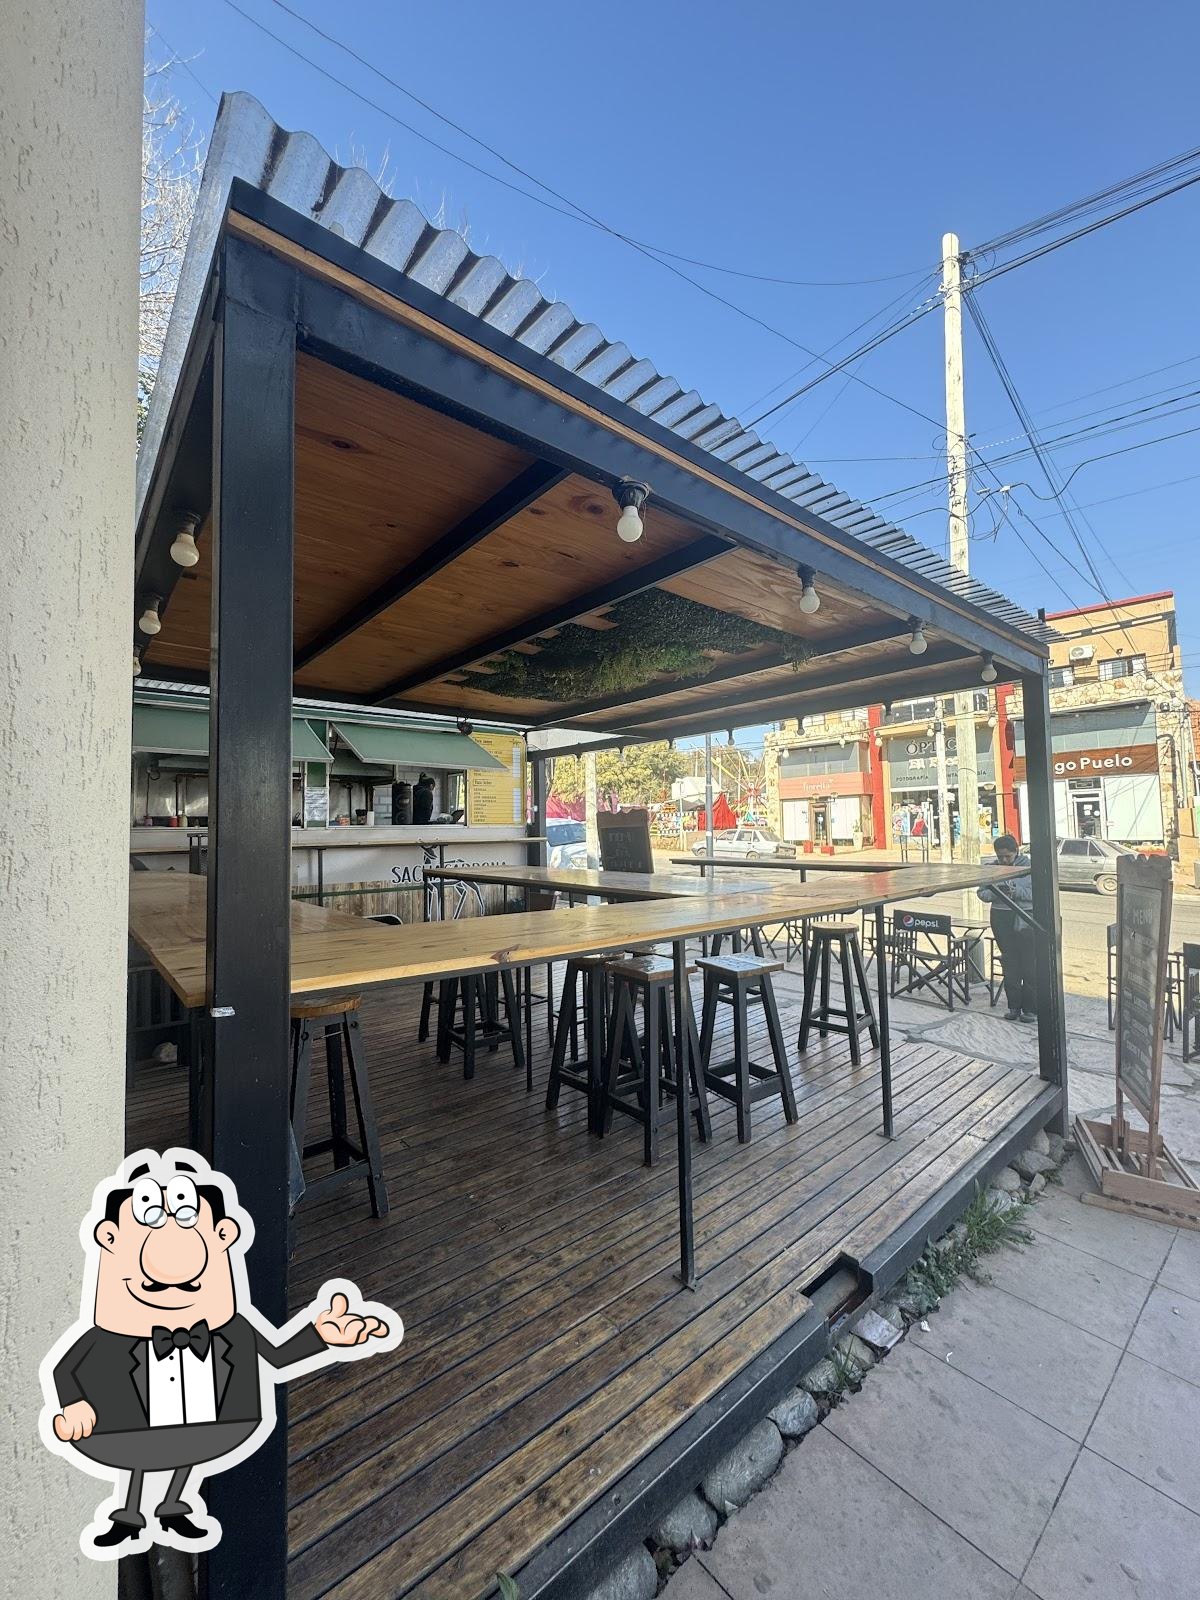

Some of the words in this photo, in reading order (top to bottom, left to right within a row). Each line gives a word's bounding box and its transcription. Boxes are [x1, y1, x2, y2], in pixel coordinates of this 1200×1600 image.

[906, 737, 957, 755] ÓPTC
[1055, 762, 1077, 774] go
[1080, 754, 1133, 770] Puelo
[914, 918, 939, 928] pepsi
